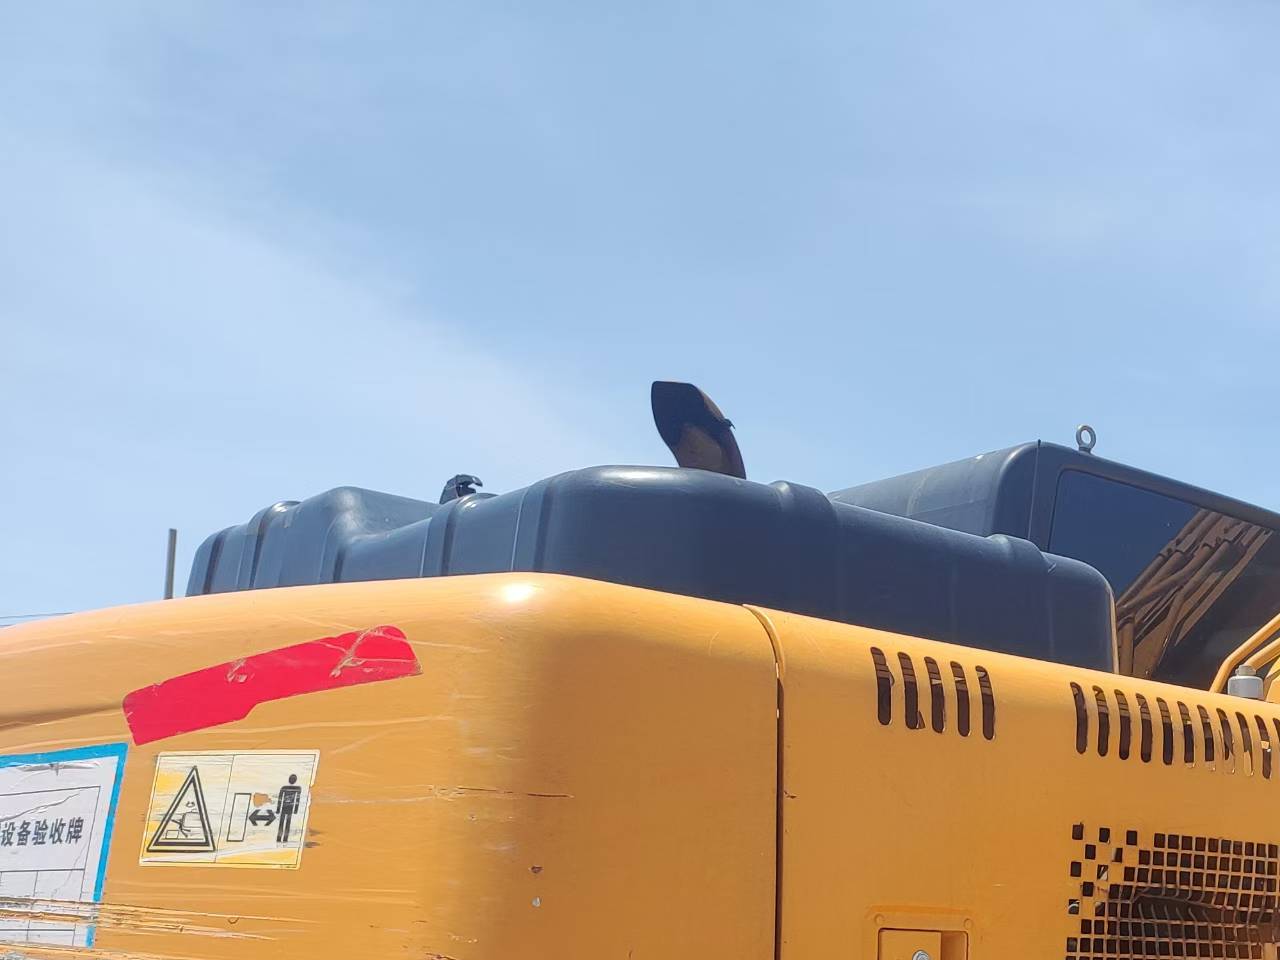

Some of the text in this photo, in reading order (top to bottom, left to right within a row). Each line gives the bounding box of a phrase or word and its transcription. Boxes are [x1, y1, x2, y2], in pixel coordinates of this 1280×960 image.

[0, 816, 85, 847] 设备验收牌
